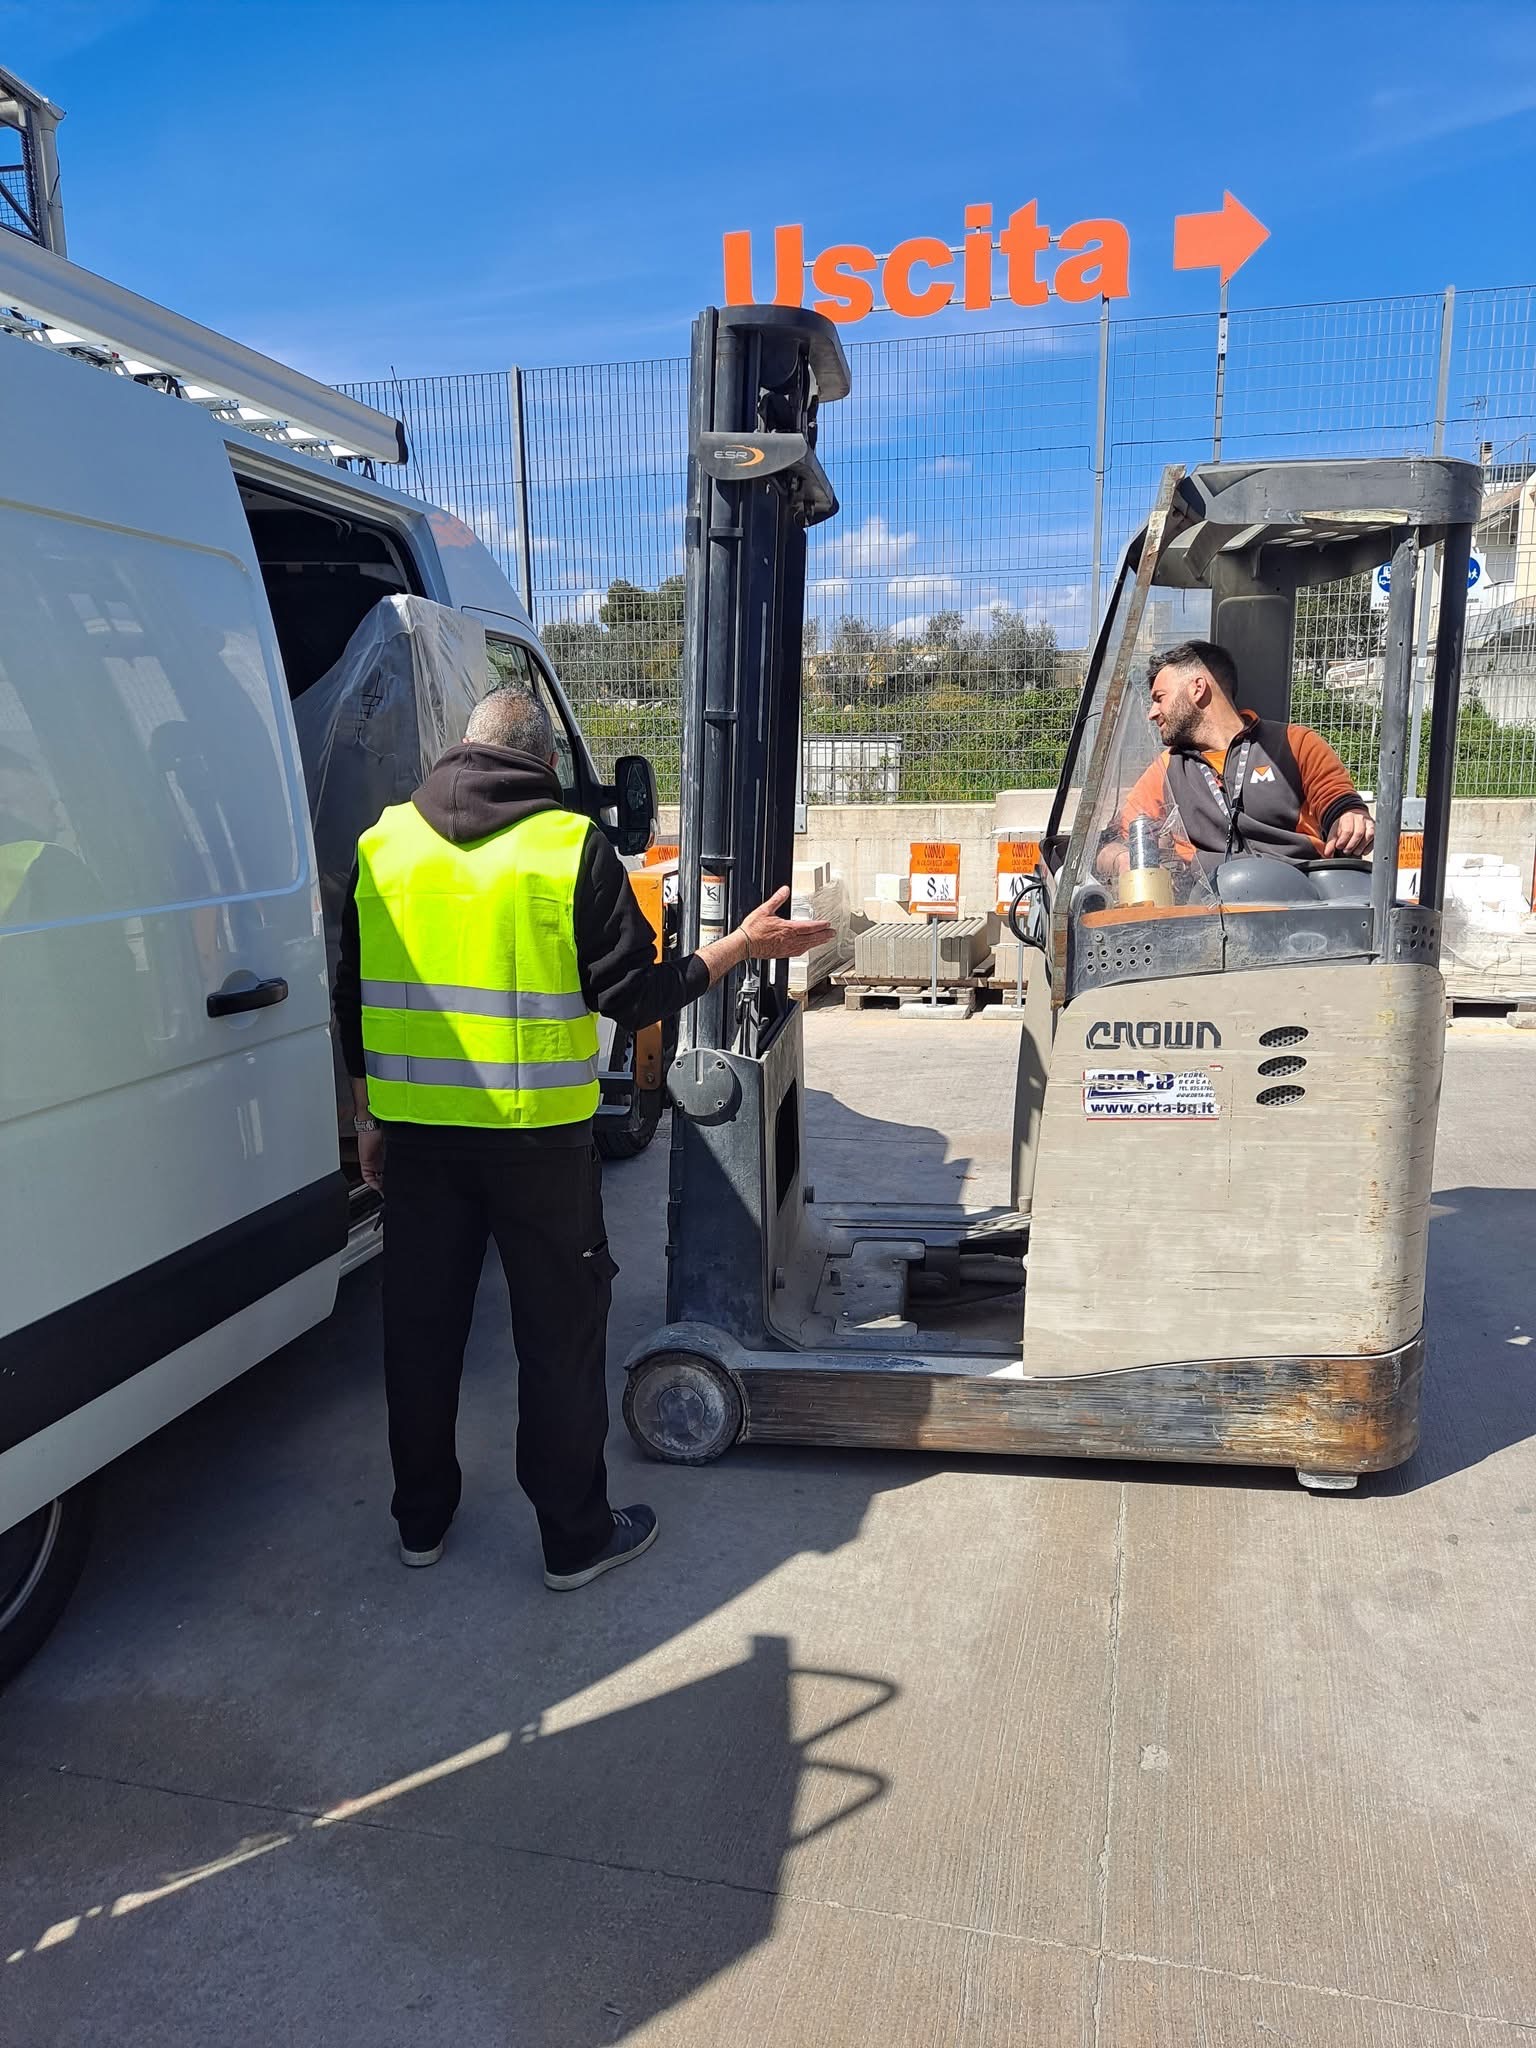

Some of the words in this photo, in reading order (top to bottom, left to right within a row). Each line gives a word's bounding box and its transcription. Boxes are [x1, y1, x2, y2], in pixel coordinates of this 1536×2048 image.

[724, 199, 1131, 324] Uscita
[714, 450, 748, 459] ESR
[1086, 1021, 1222, 1050] CROWN
[1091, 1102, 1214, 1115] www.orta-bg.it
